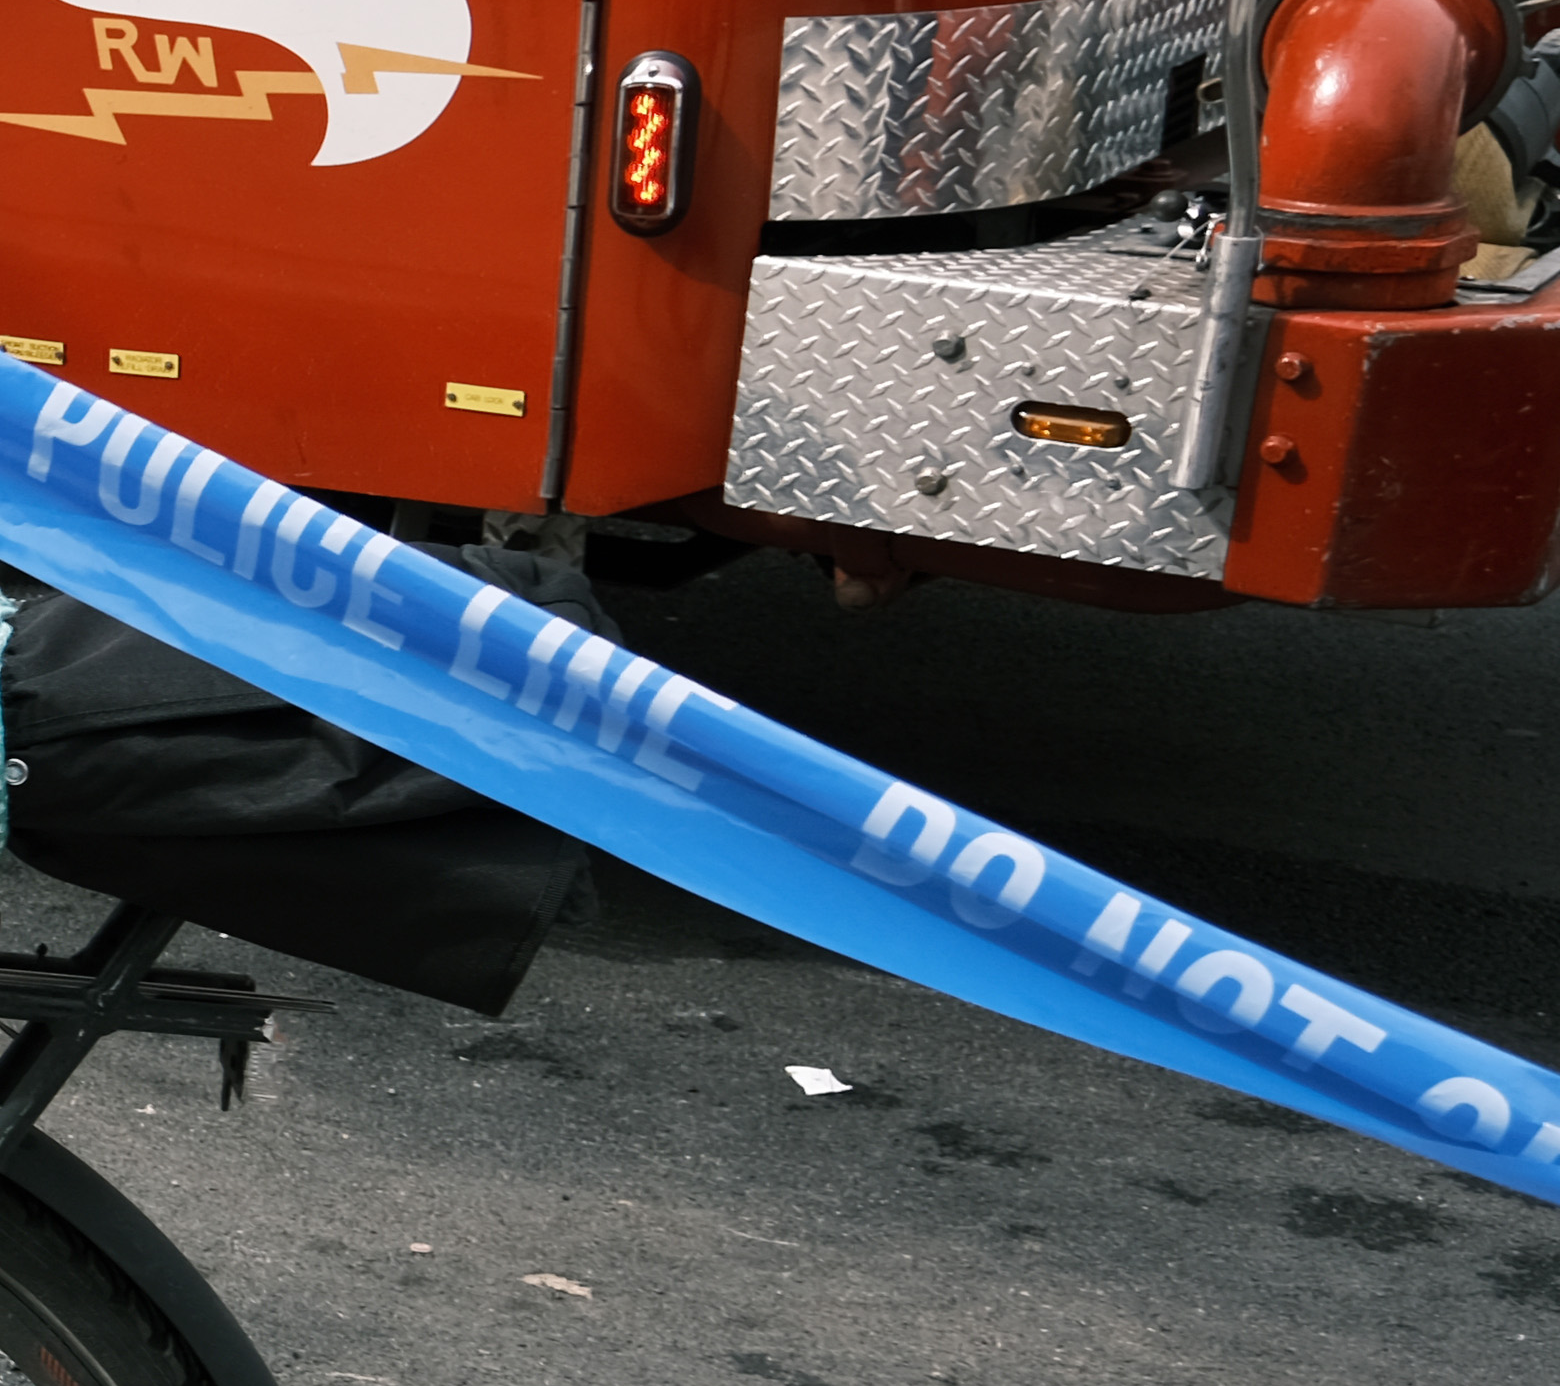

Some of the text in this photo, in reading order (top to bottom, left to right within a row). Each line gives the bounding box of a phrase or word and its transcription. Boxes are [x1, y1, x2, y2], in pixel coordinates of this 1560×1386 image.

[92, 18, 217, 88] RW
[27, 380, 1387, 1074] POLICE LINE DO NOT
